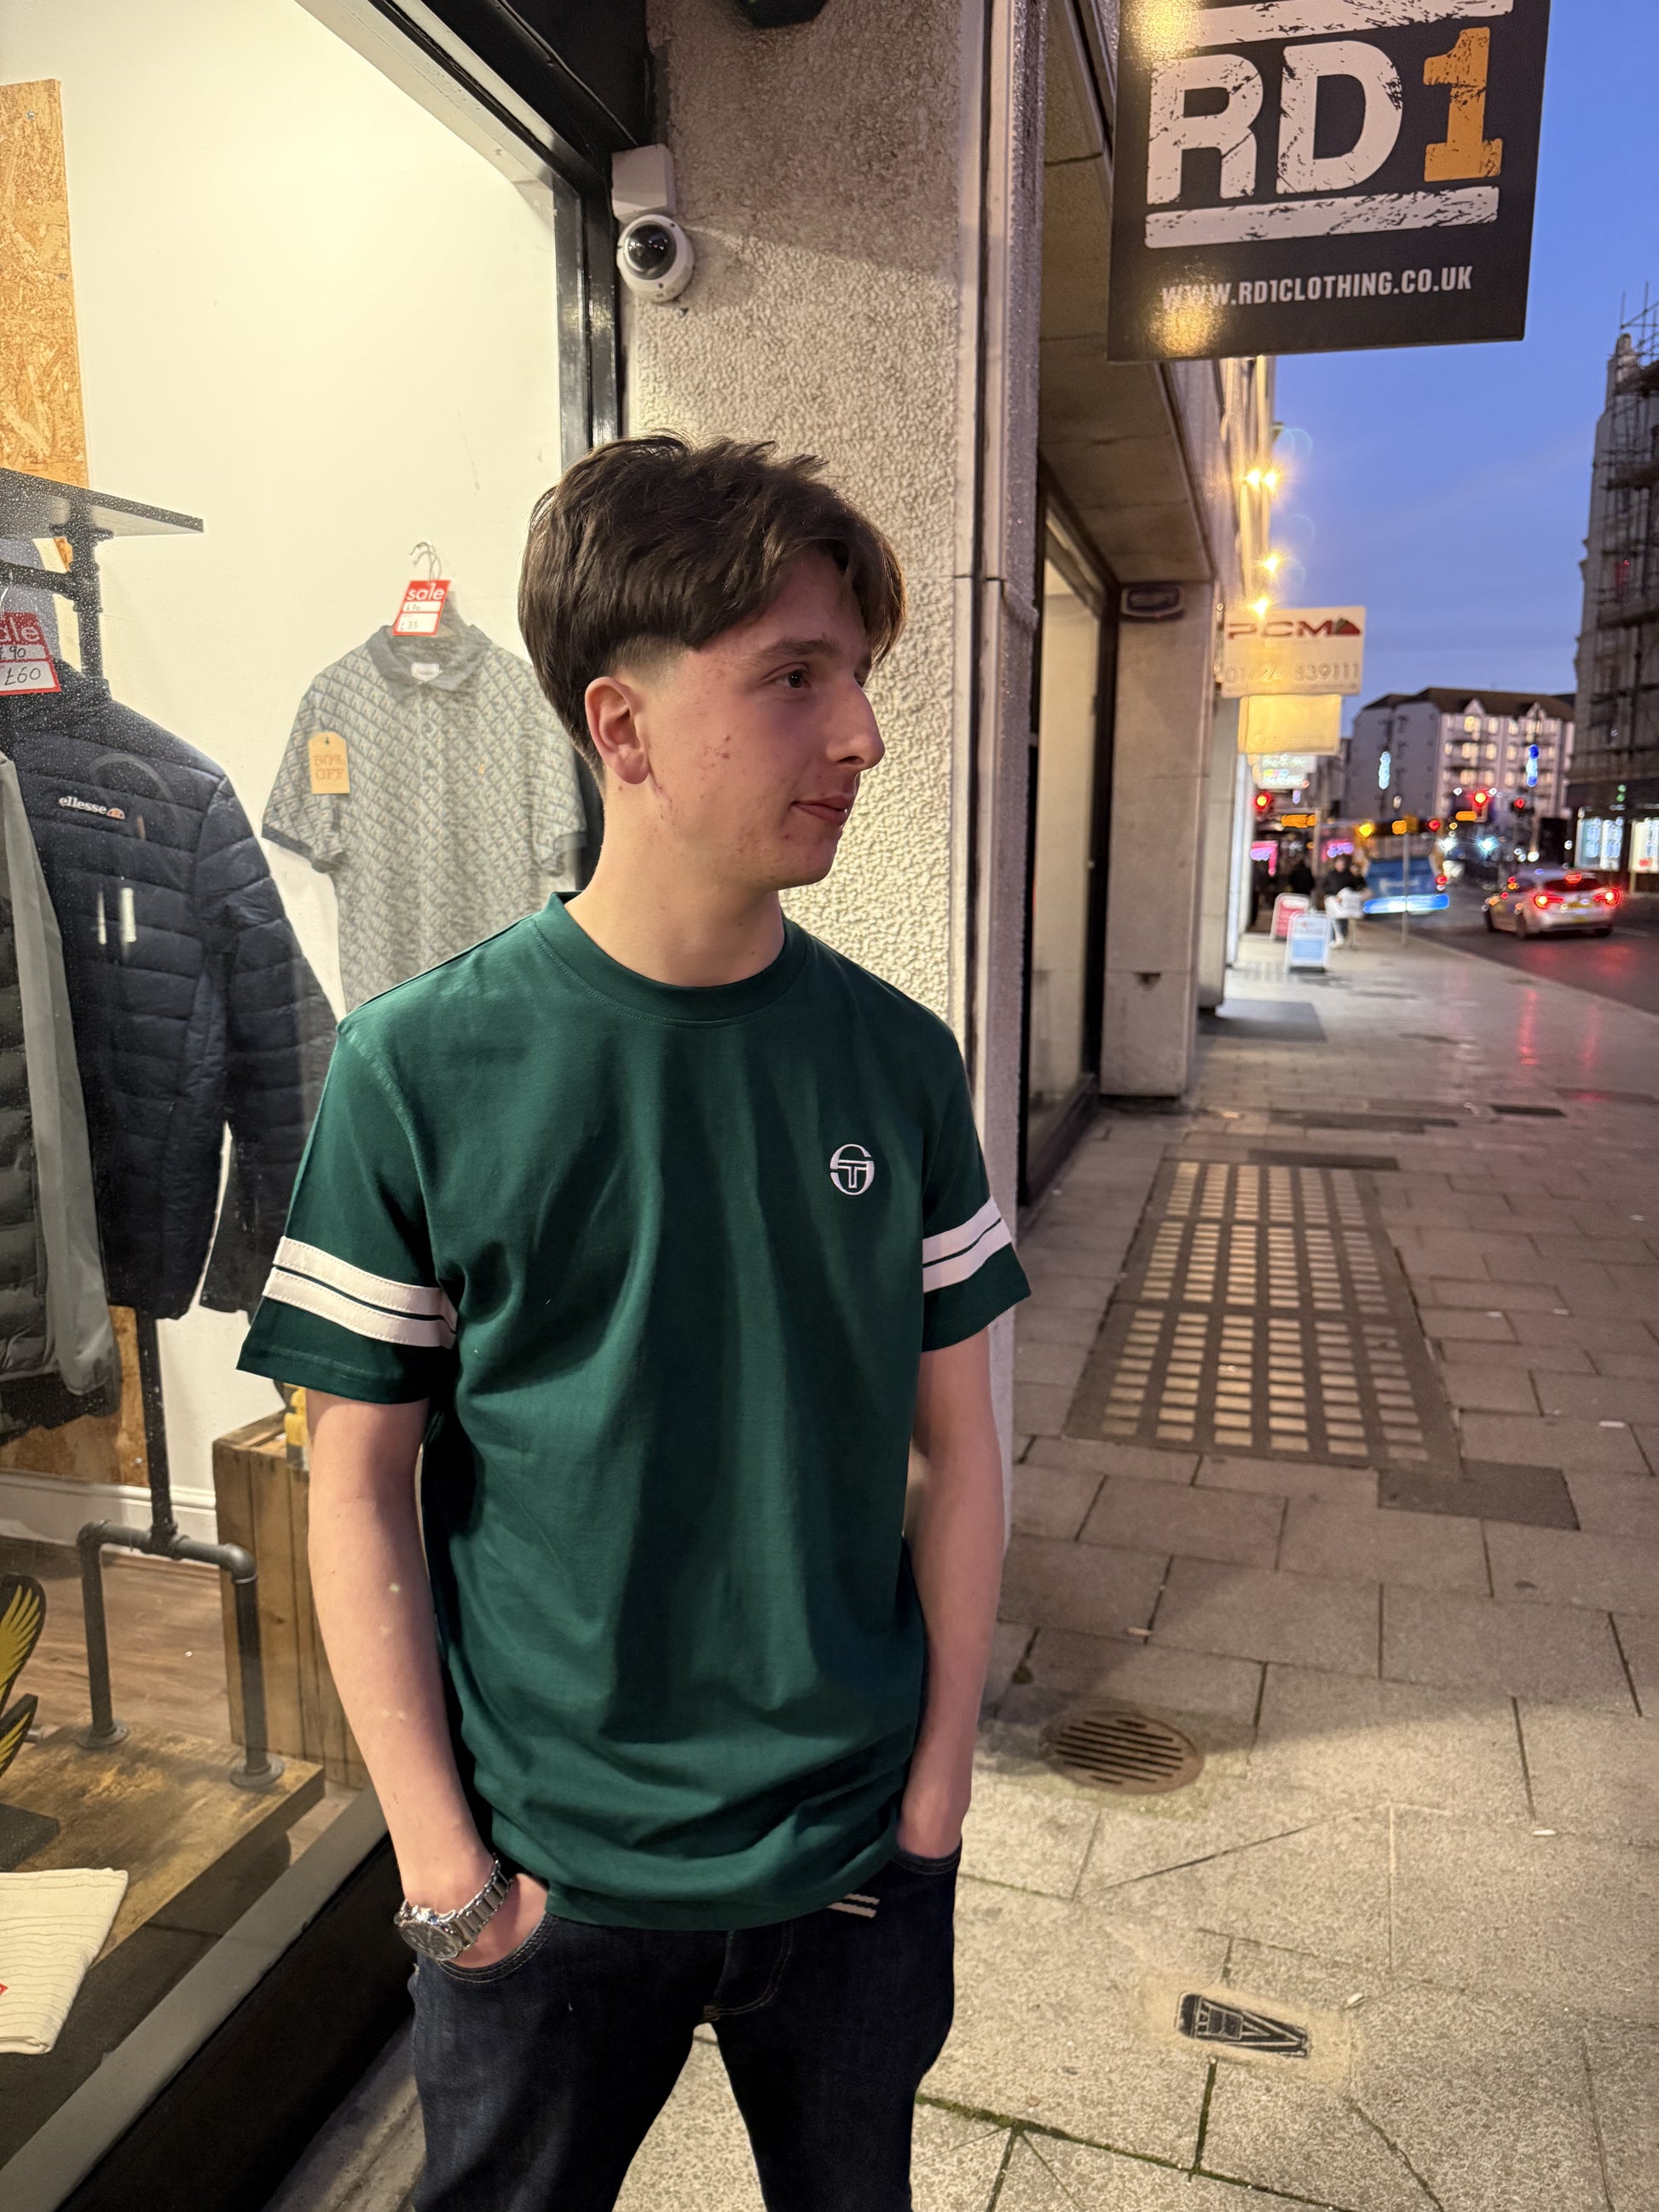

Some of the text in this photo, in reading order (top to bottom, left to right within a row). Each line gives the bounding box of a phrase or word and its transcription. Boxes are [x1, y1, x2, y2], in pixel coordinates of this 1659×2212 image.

[1147, 27, 1503, 205] RD1
[1161, 266, 1473, 309] WWW.RD1CLOTHING.CO.UK
[406, 582, 445, 601] sale
[0, 616, 40, 642] ale
[1228, 620, 1333, 639] PCM
[4, 667, 41, 685] £60
[315, 768, 345, 781] OFF
[58, 795, 107, 815] ellesse
